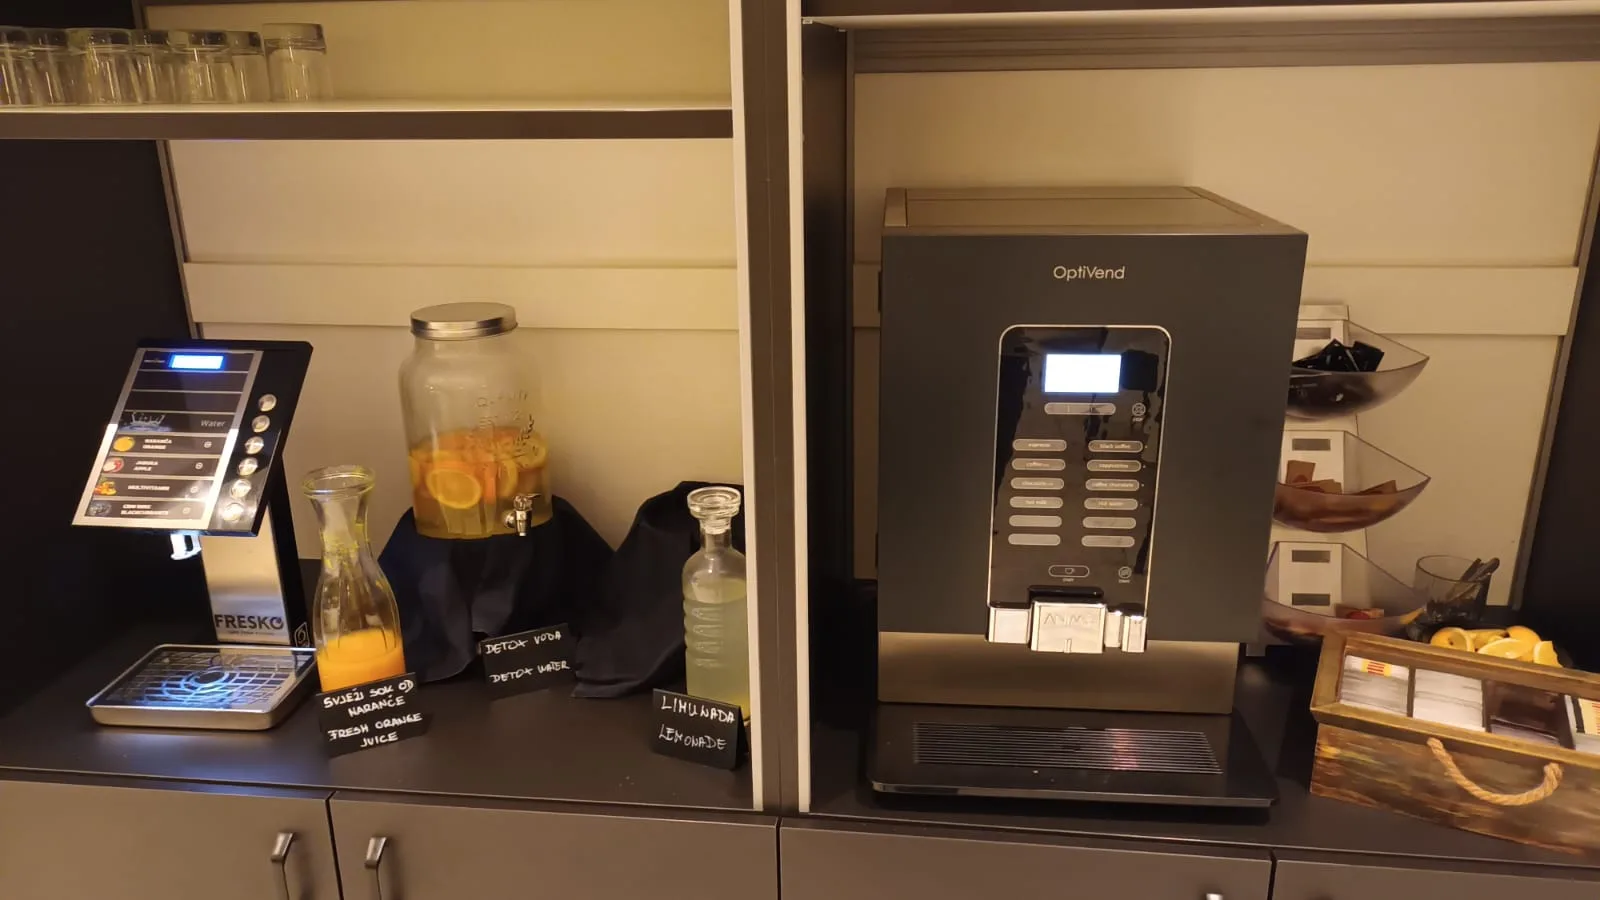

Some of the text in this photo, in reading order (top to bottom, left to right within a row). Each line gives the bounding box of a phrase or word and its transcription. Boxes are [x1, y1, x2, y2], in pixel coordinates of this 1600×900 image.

[1053, 265, 1126, 281] OptiVend
[201, 419, 226, 428] Water
[214, 614, 284, 630] FRESKO
[485, 630, 562, 655] DETOX VODA
[489, 660, 571, 683] DETOX WATER
[369, 685, 394, 698] SOK
[661, 695, 735, 724] LIMUNADA
[327, 712, 423, 742] FRESH ORANGE
[658, 723, 728, 751] LEMONADE
[360, 731, 399, 748] JUICE
